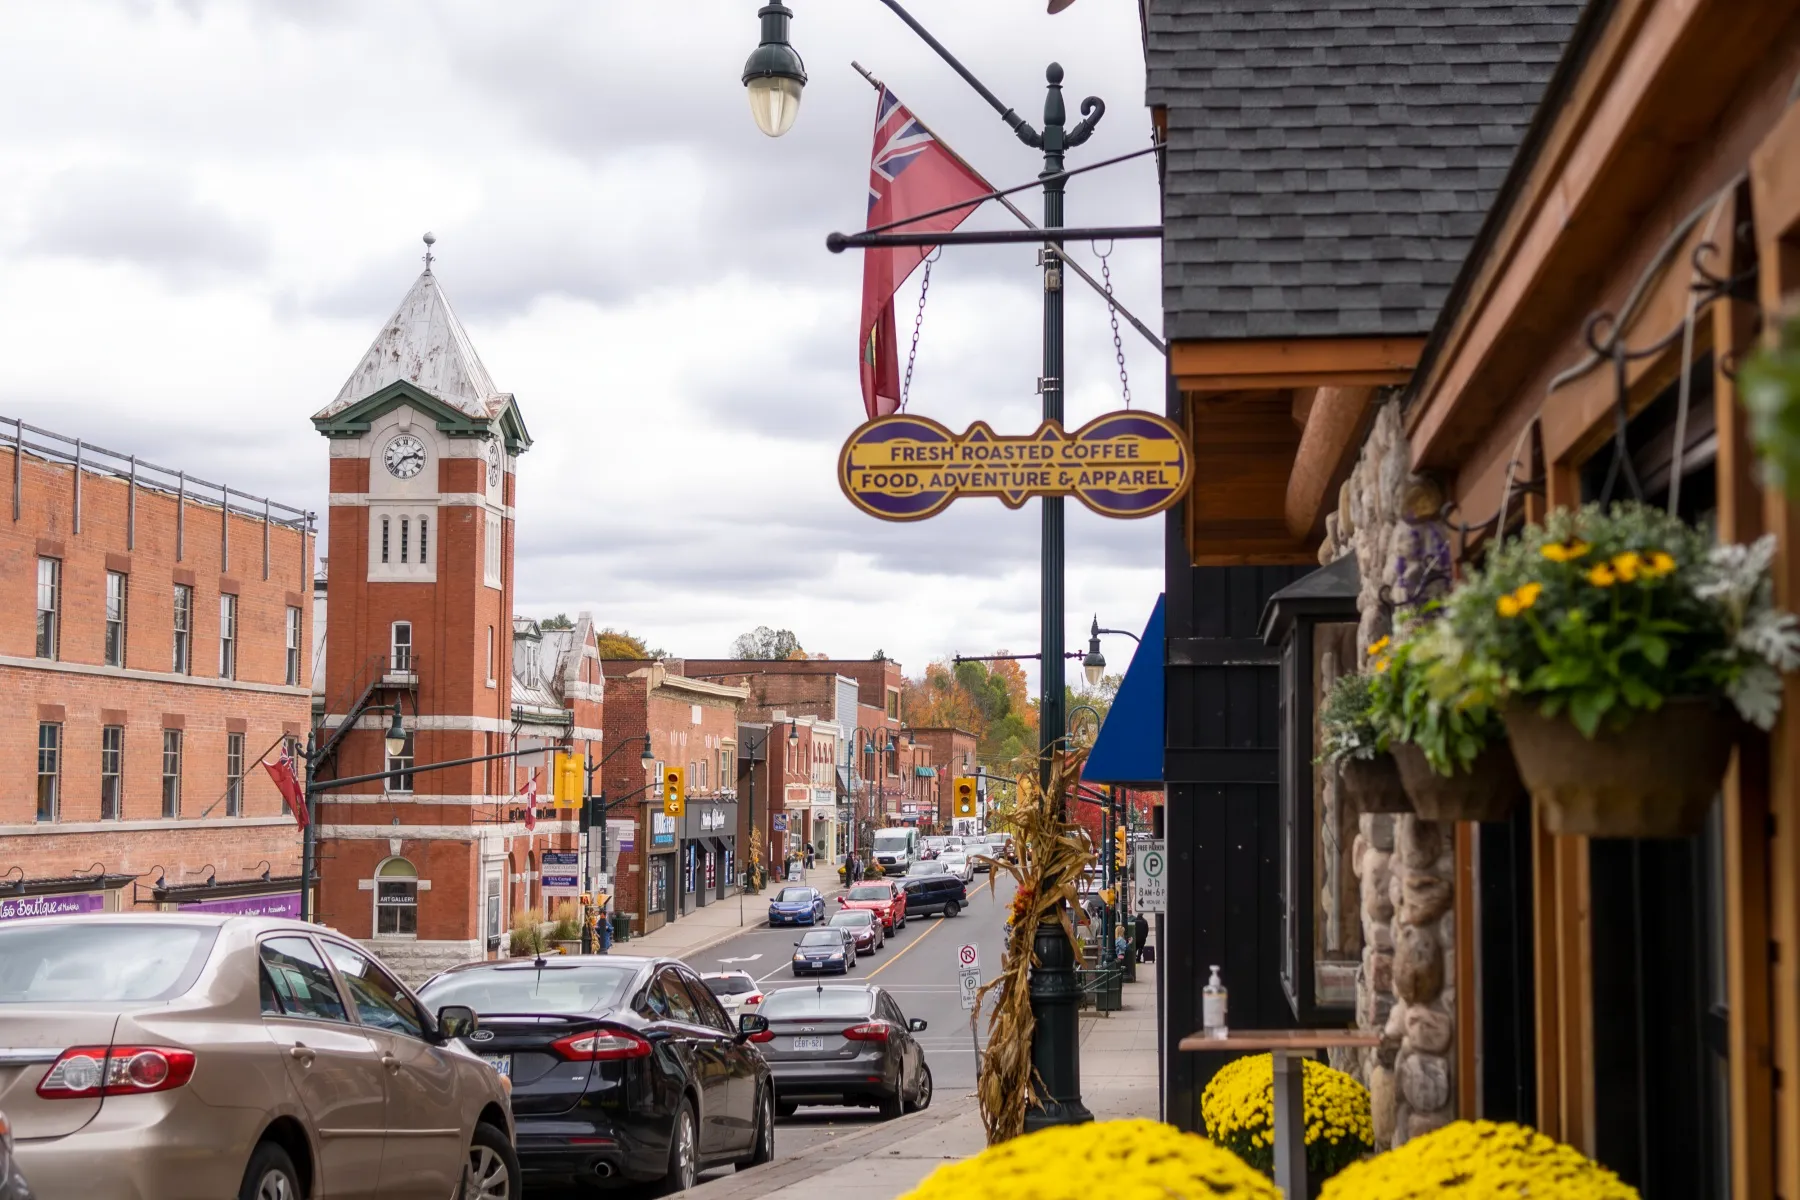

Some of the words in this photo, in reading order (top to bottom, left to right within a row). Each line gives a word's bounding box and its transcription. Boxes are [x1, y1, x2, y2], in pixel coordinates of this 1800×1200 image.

[890, 446, 955, 462] FRESH
[961, 444, 1055, 461] ROASTED
[1061, 443, 1140, 460] COFFEE
[861, 472, 925, 490] FOOD,
[929, 471, 1052, 488] ADVENTURE
[1058, 471, 1074, 487] &
[1077, 469, 1169, 487] APPAREL
[1137, 844, 1148, 852] FREE
[1149, 844, 1165, 852] PARKIN
[1147, 878, 1153, 888] 3
[1154, 878, 1160, 888] h
[17, 895, 57, 917] Boutique
[475, 1031, 489, 1040] Ford
